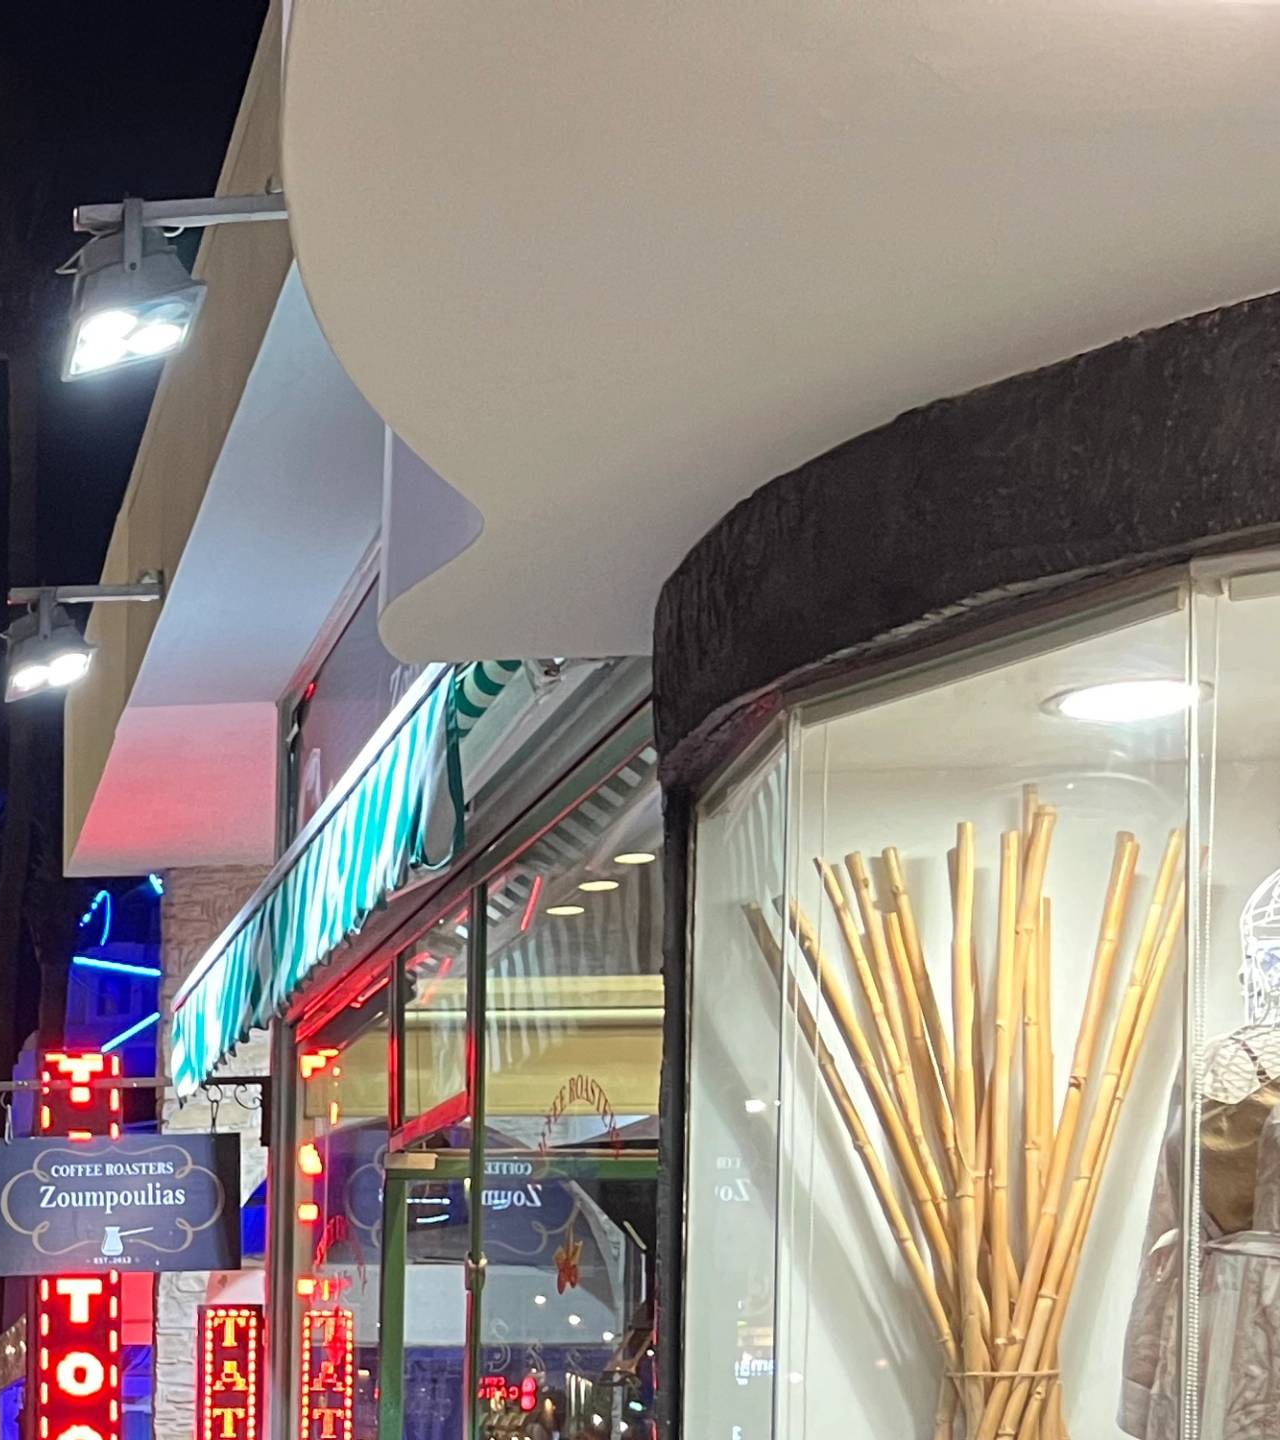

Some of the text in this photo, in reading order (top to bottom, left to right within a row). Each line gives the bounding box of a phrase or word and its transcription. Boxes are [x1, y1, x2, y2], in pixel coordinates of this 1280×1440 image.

[51, 1161, 174, 1177] COFFEE ROASTERS
[39, 1183, 186, 1214] Zoumpoulias
